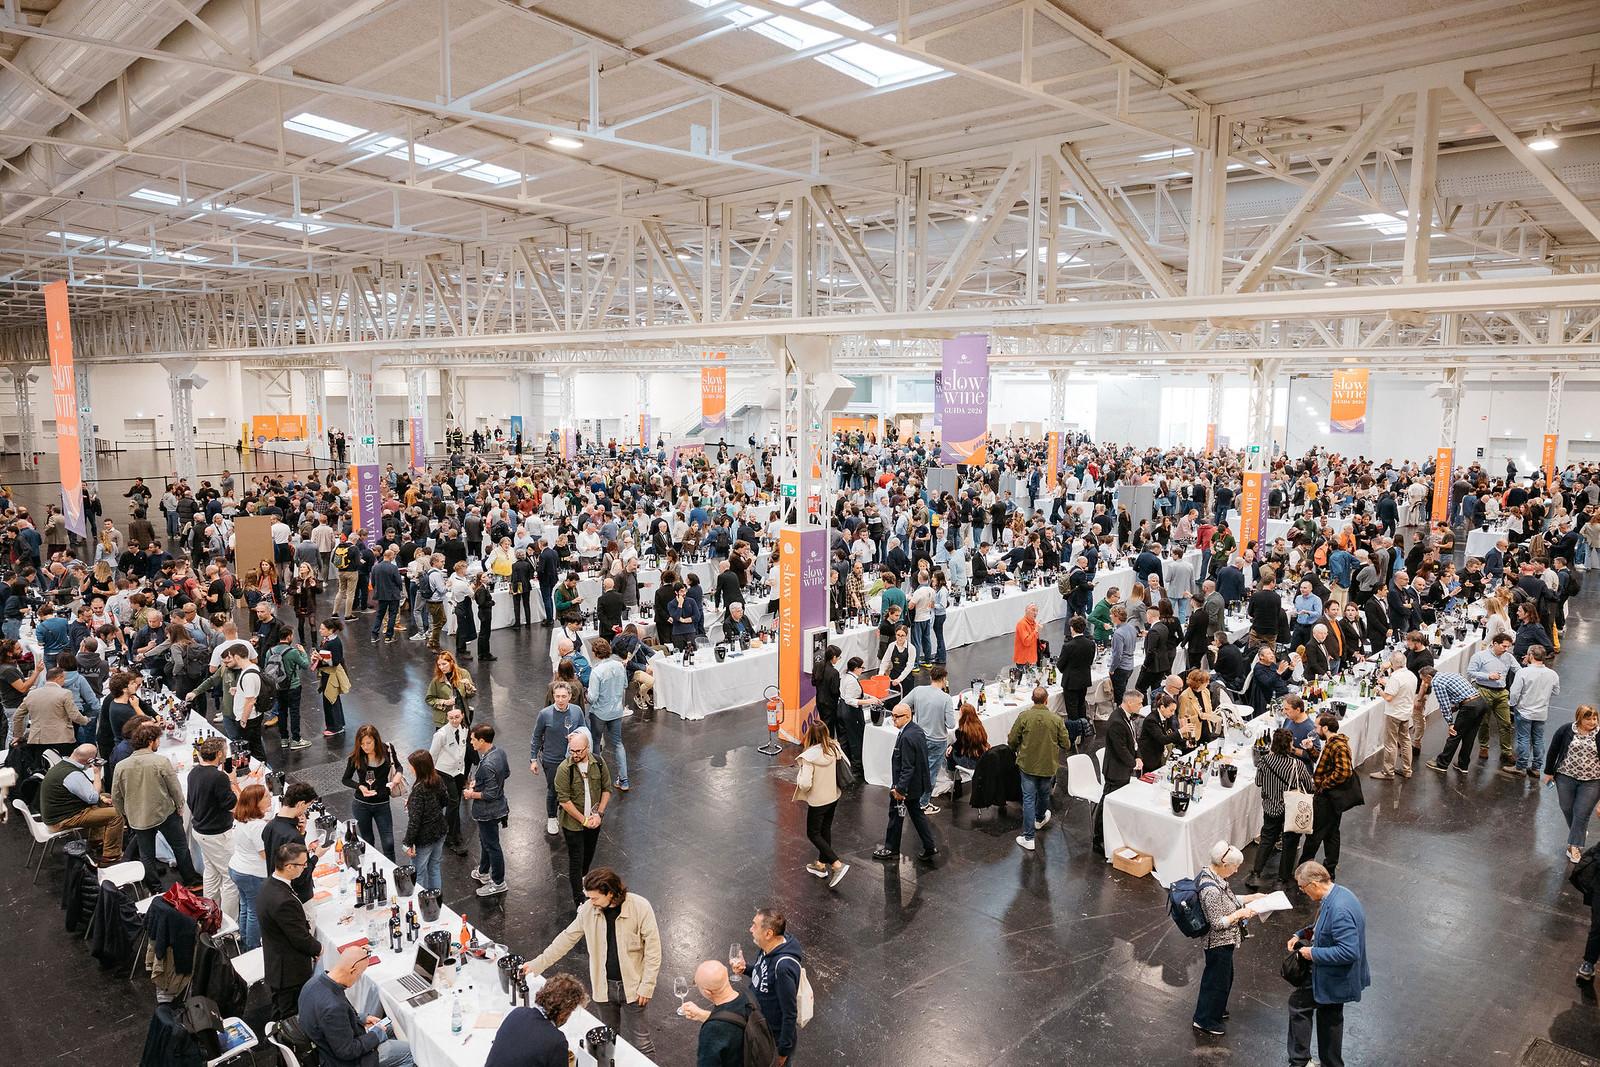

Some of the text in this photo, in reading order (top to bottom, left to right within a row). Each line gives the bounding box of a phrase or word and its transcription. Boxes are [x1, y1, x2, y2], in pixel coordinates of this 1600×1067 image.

[53, 349, 73, 391] slow
[702, 371, 723, 385] slow
[943, 368, 985, 391] slow
[1334, 377, 1364, 390] slow
[702, 385, 725, 394] wine
[1334, 390, 1366, 399] wine
[943, 391, 985, 406] wine
[1246, 492, 1257, 513] slow
[364, 484, 379, 550] slow wine
[803, 565, 825, 579] slow
[803, 576, 825, 587] wine
[783, 563, 796, 647] slow wine
